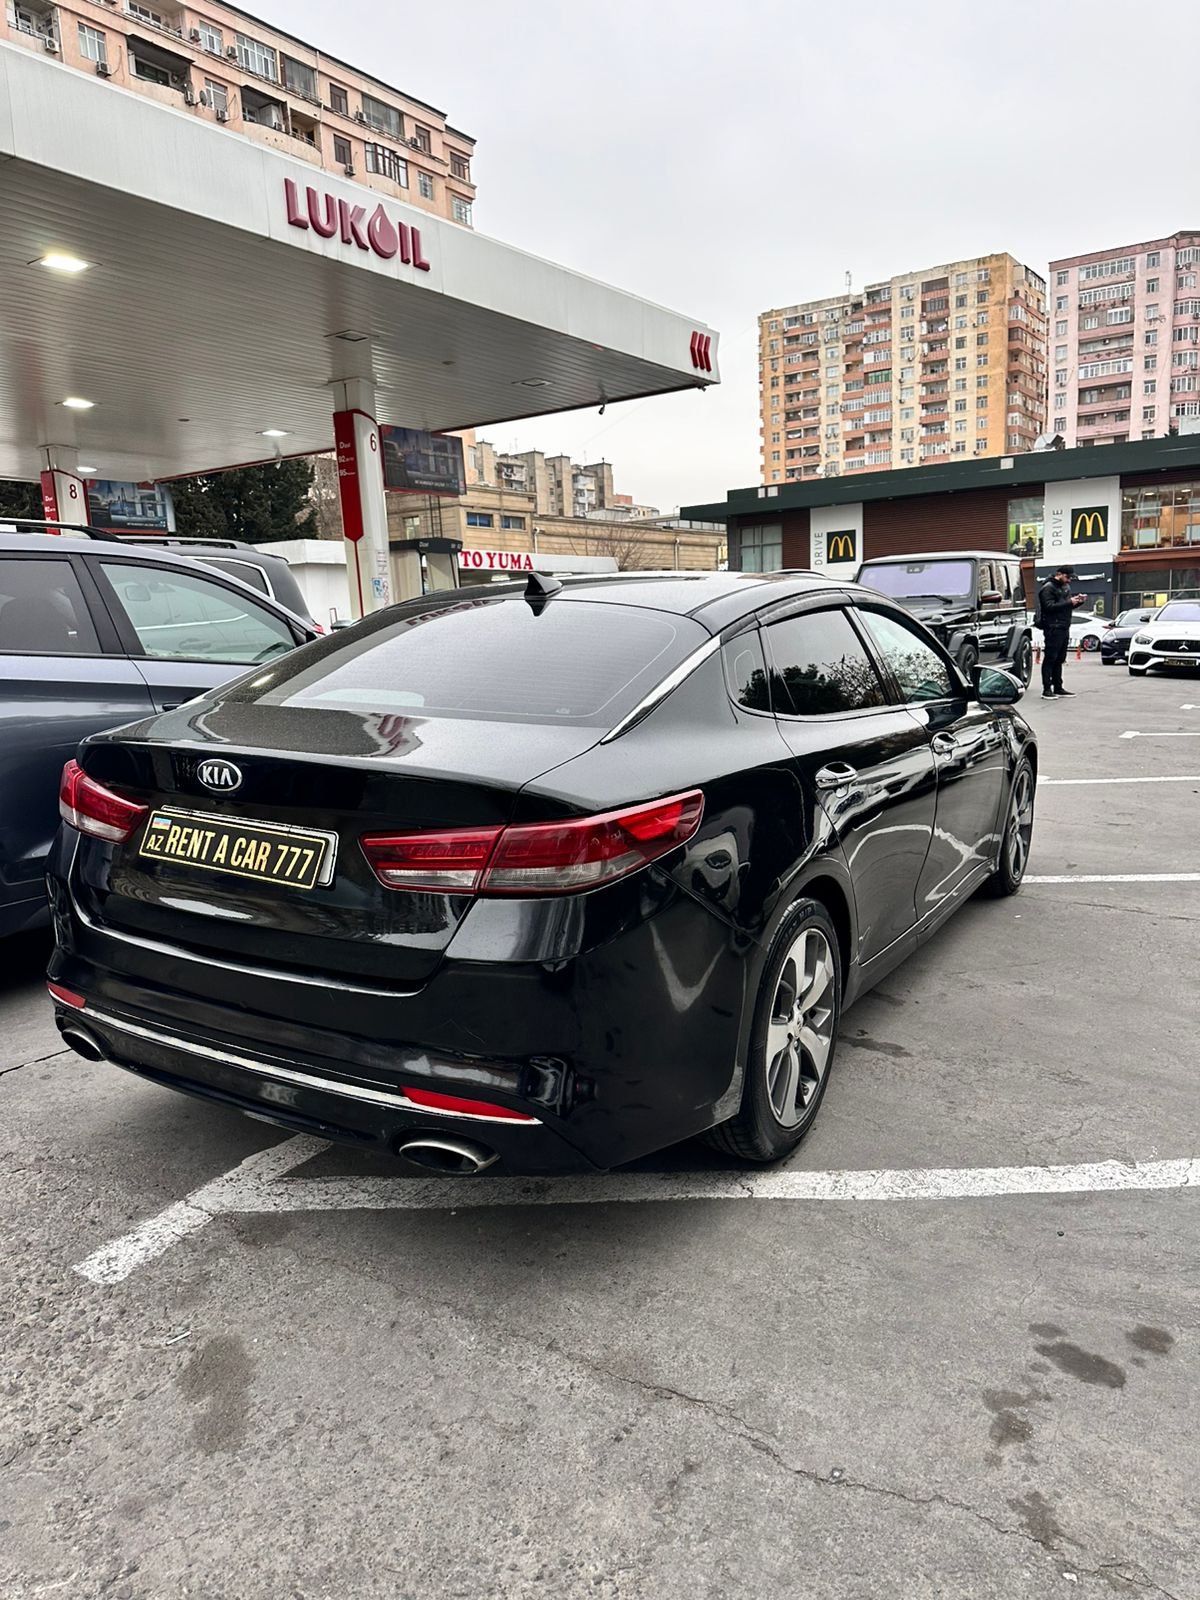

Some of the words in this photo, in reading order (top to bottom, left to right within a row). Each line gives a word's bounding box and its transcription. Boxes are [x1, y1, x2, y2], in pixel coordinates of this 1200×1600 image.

[284, 178, 431, 272] LUKOIL
[370, 433, 377, 452] 6
[69, 484, 78, 499] 8
[1051, 509, 1063, 546] DRIVE
[814, 532, 823, 566] DRIVE
[202, 765, 234, 786] KIA
[146, 834, 164, 851] AZ
[165, 825, 216, 860] RENT
[213, 834, 230, 864] A
[230, 837, 272, 872] CAR
[272, 845, 315, 879] 777
